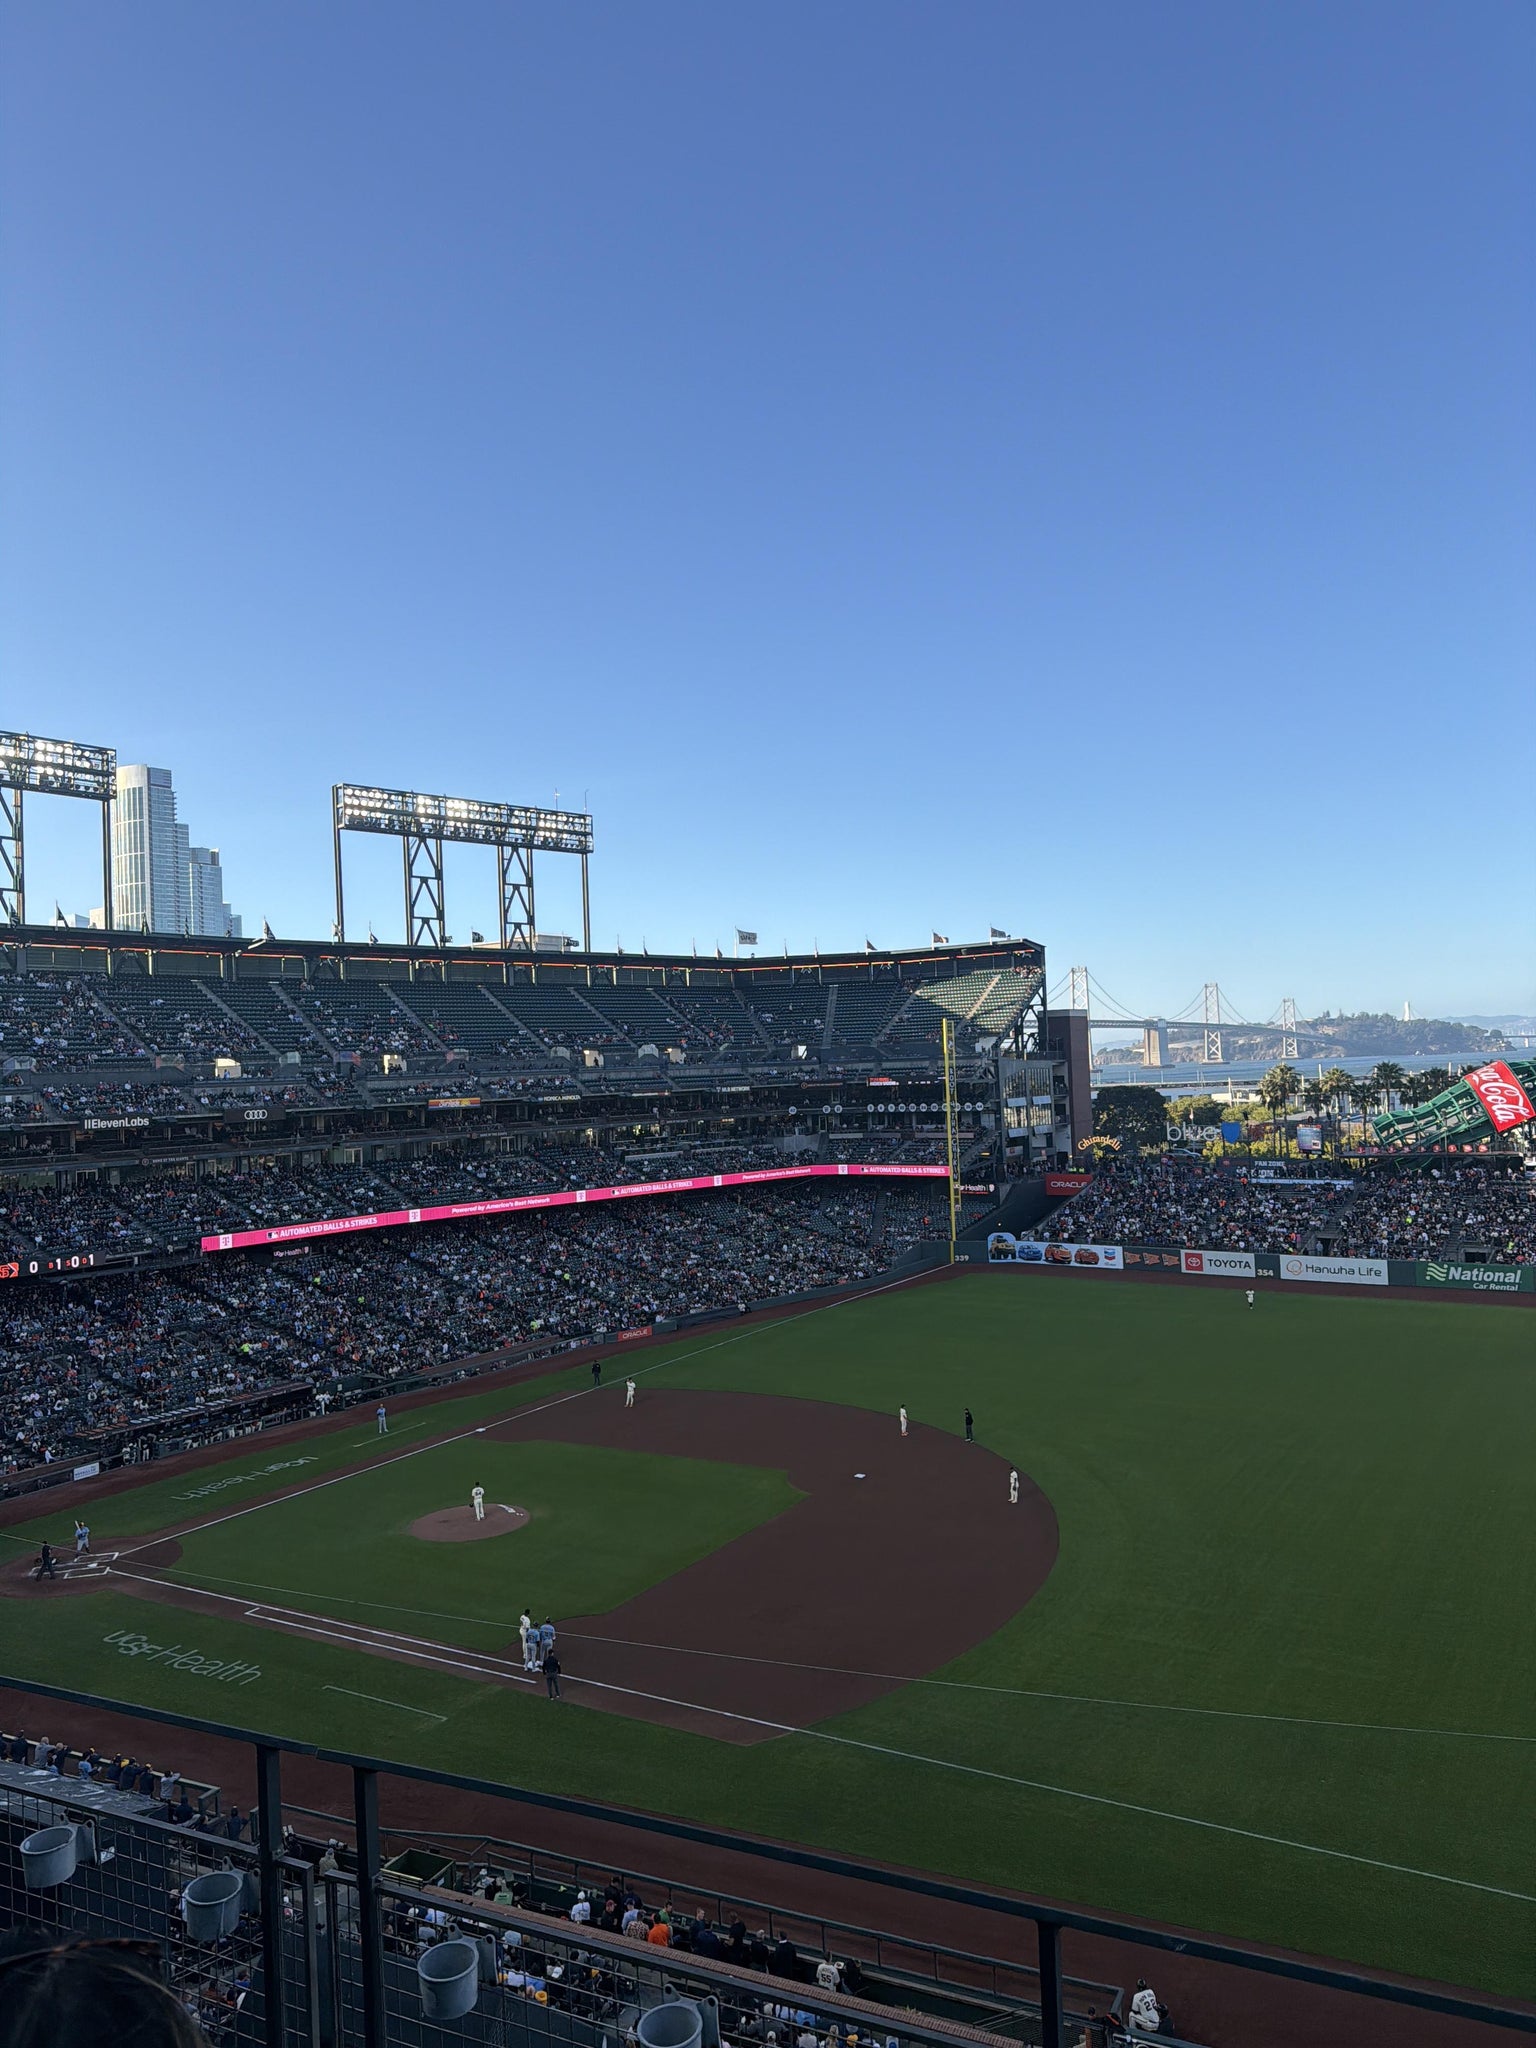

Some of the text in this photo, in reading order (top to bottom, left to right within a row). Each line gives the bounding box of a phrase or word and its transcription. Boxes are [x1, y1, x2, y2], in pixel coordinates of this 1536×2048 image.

[1473, 1062, 1531, 1123] ca-Cola
[1077, 1134, 1122, 1151] Ghirardelli
[620, 1185, 652, 1194] AUTOMATED
[672, 1180, 693, 1188] STRIKES
[451, 1196, 550, 1214] Powered by America's Best Network
[279, 1224, 323, 1237] AUTOMATED
[323, 1221, 344, 1232] BALLS
[350, 1216, 378, 1228] STRIKES
[285, 1247, 302, 1256] Health
[30, 1261, 38, 1273] 0
[56, 1258, 61, 1270] 1
[71, 1256, 79, 1268] 0
[89, 1254, 94, 1266] 1
[1207, 1258, 1252, 1269] TOYOTA
[1306, 1264, 1382, 1276] Hanwha Life
[1448, 1267, 1522, 1283] National
[1489, 1283, 1519, 1291] Rental
[622, 1329, 648, 1339] ORACLE
[170, 1470, 270, 1500] Health
[103, 1630, 262, 1686] UCSF Health
[821, 1973, 831, 1983] 55
[1144, 1999, 1158, 2011] 22
